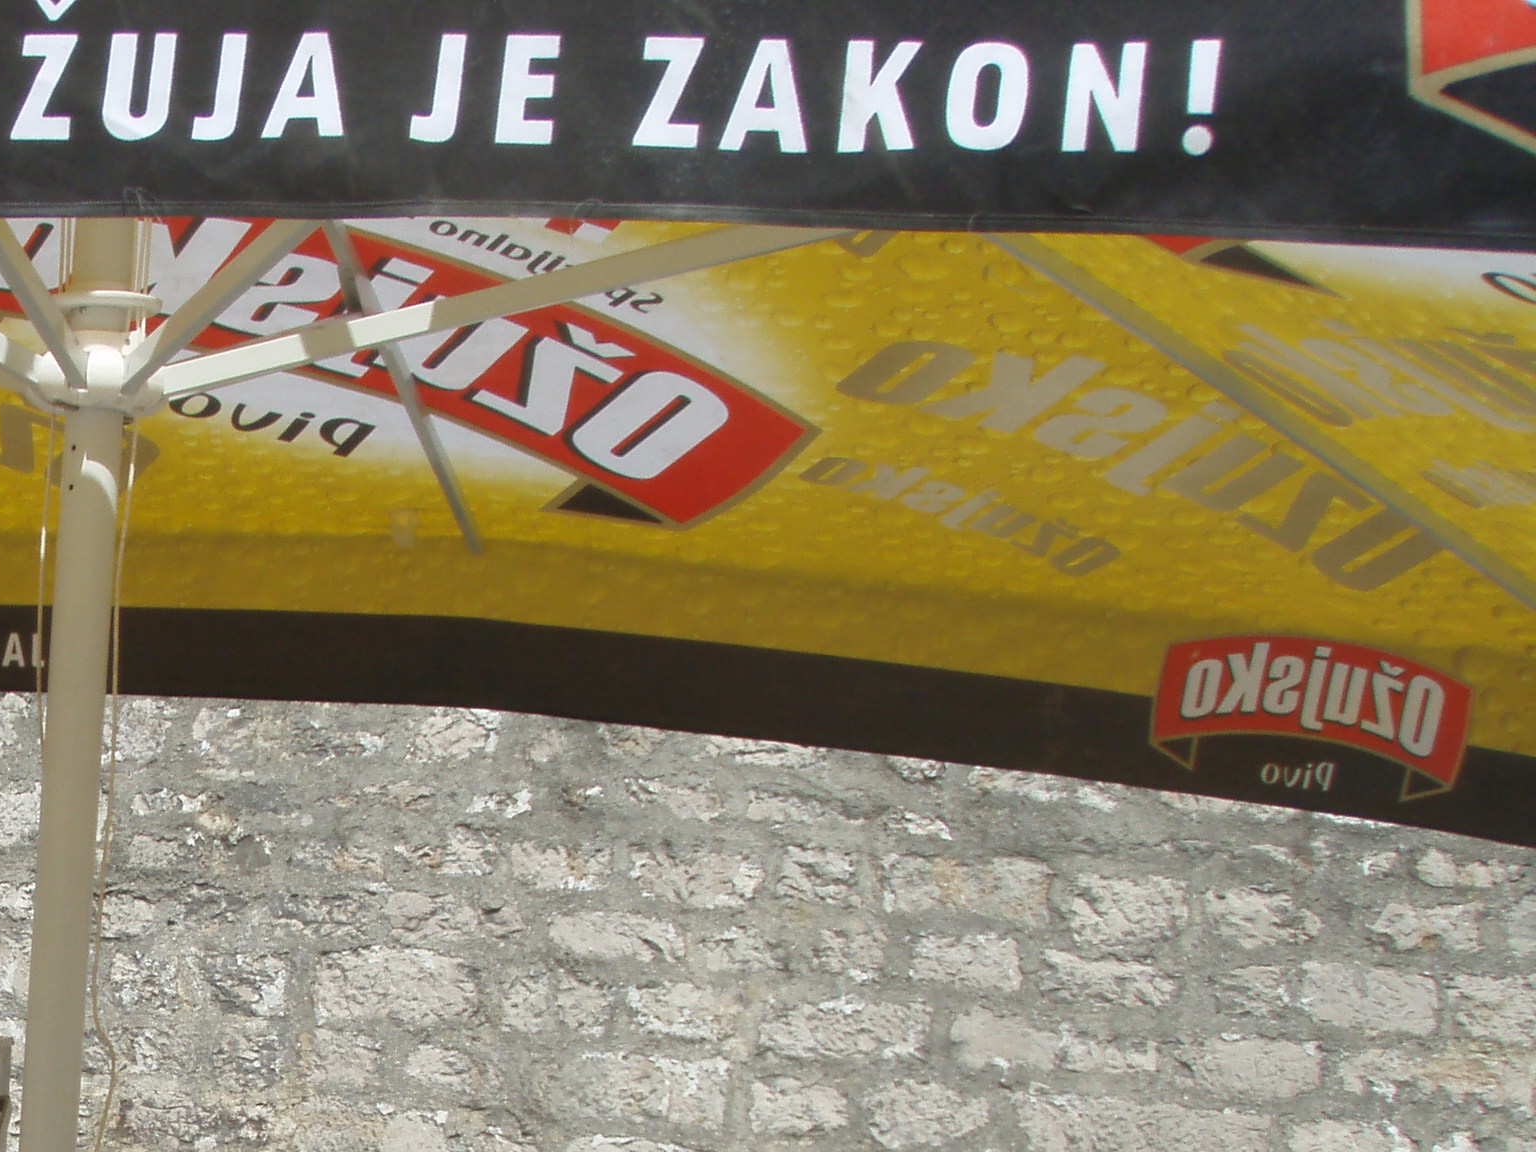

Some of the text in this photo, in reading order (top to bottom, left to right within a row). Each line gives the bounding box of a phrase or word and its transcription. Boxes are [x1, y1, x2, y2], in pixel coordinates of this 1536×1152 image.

[10, 0, 1224, 157] ŽUJA JE ZAKON!
